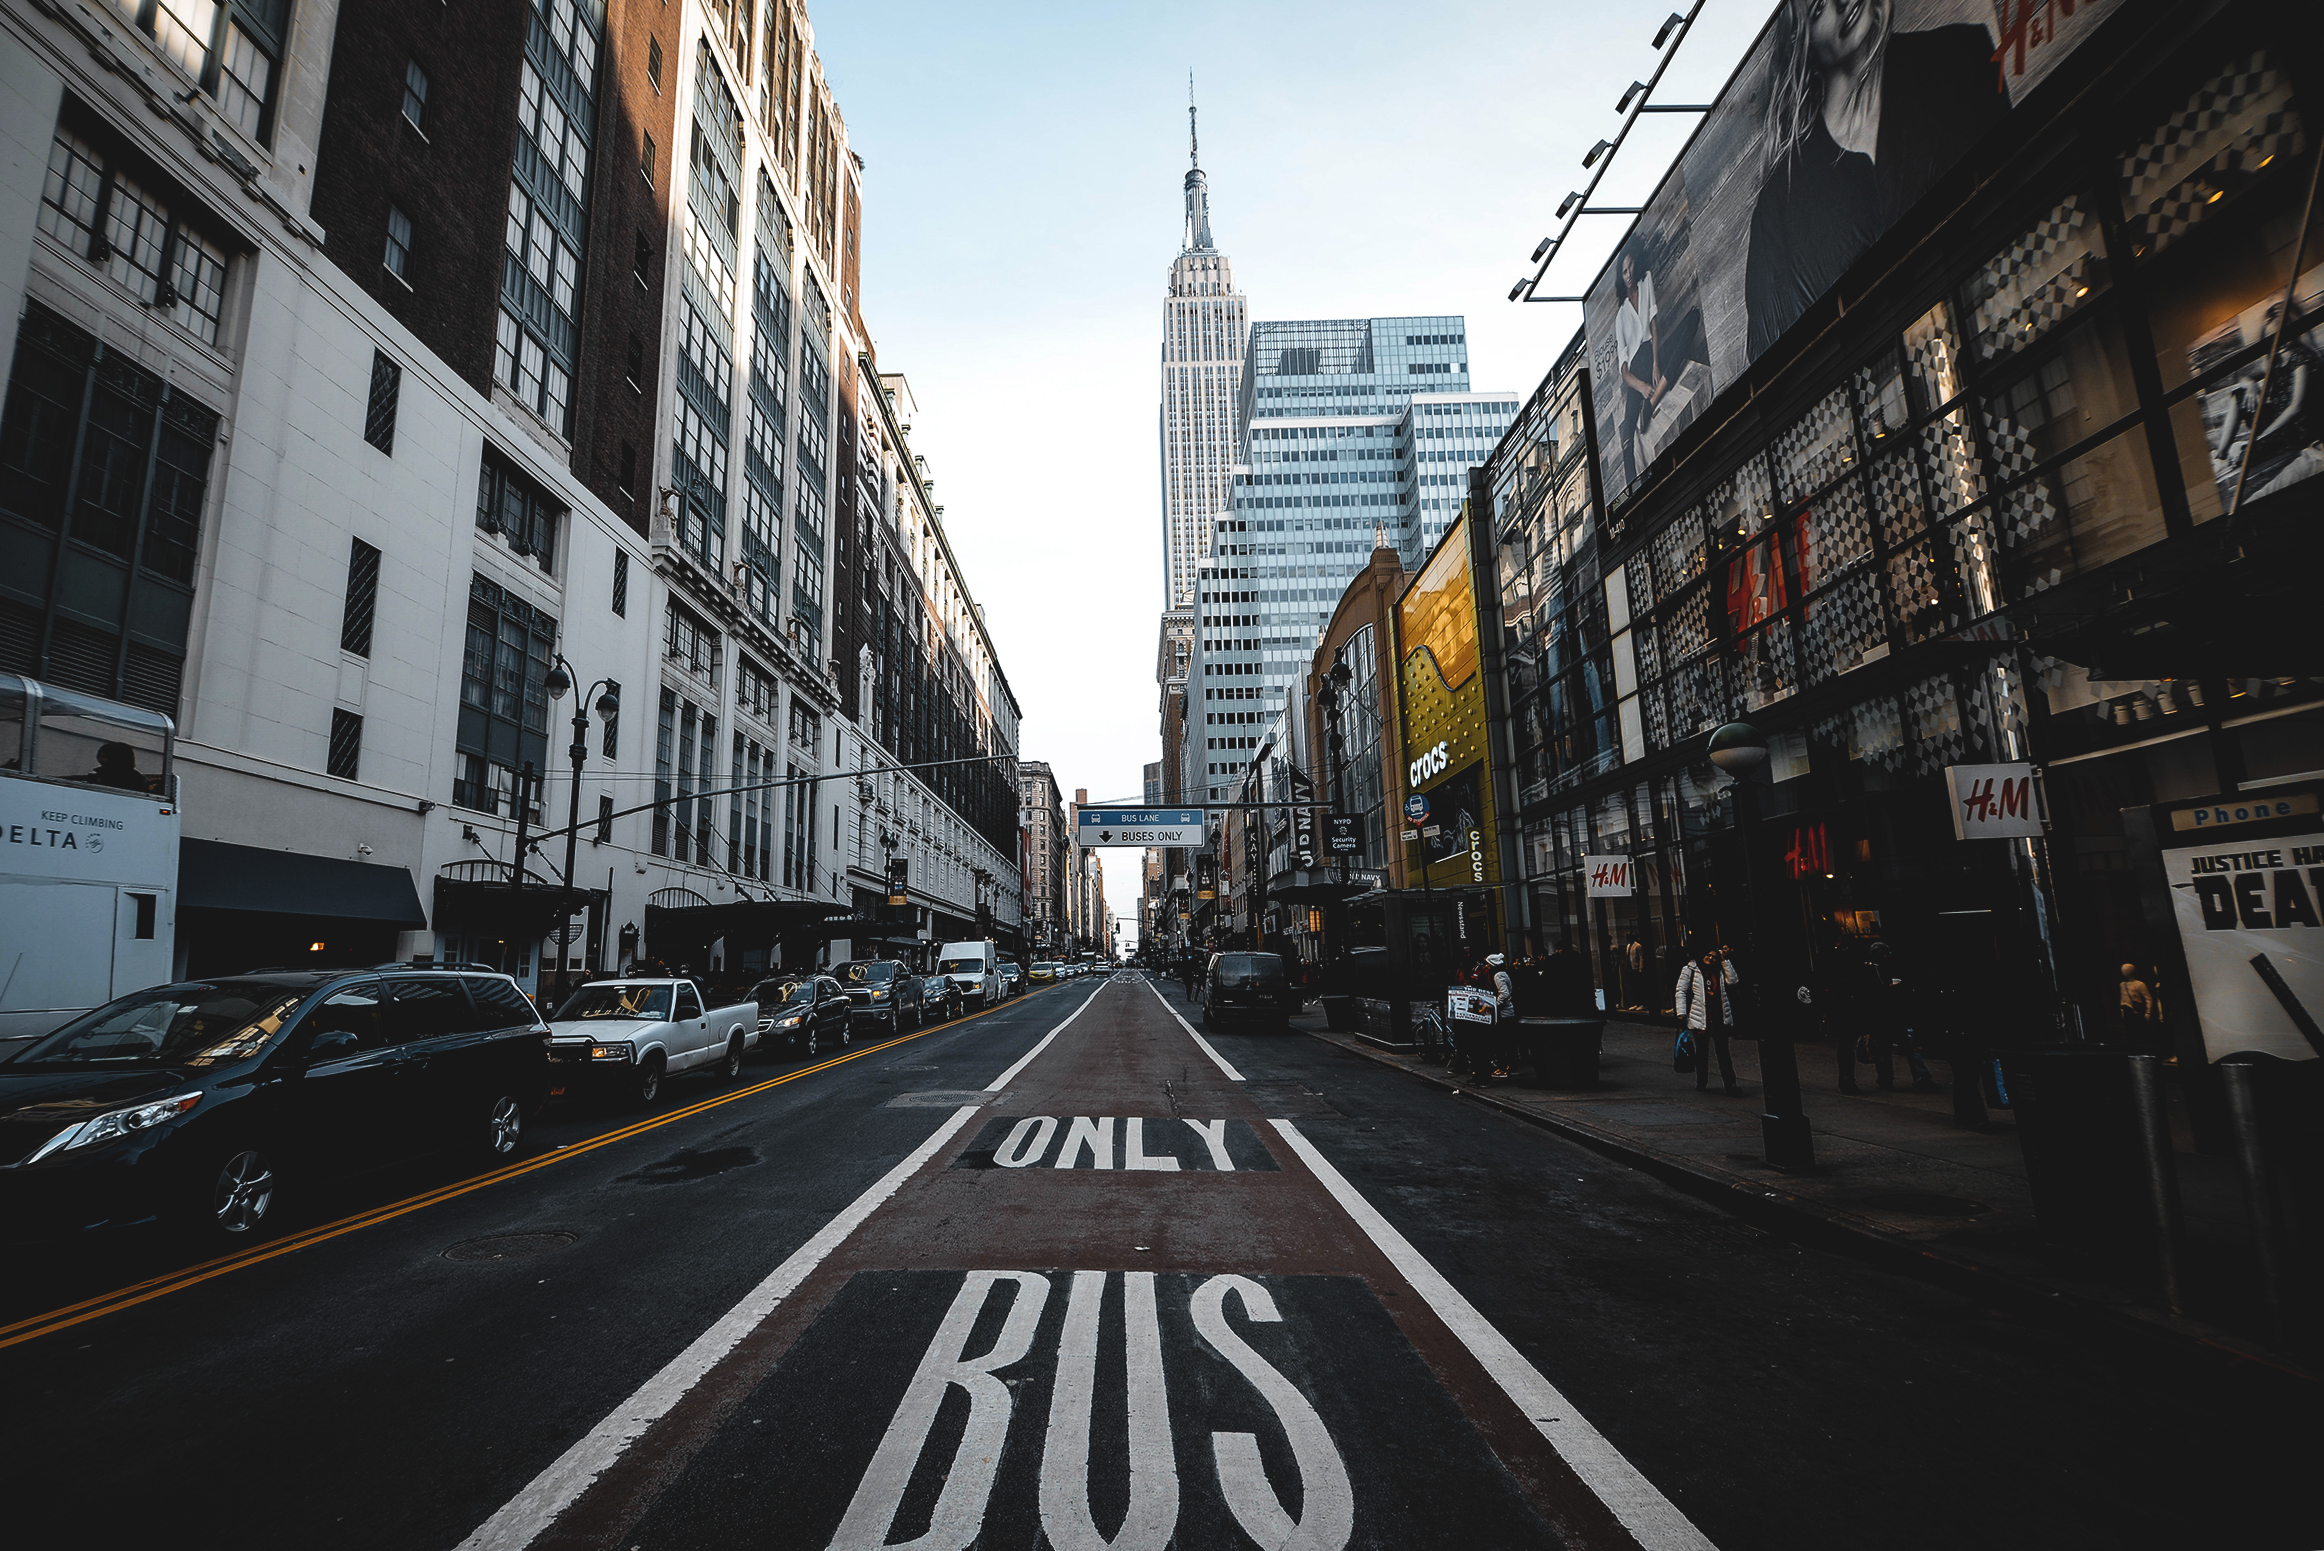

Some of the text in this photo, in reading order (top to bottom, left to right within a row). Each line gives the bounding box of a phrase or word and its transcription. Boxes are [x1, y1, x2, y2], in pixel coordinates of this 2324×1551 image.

[1410, 740, 1448, 788] crocs
[1294, 782, 1311, 830] NAVY
[1963, 776, 2029, 822] H&M
[2194, 801, 2291, 826] Phone
[41, 810, 124, 830] KEEP CLIMBING
[1121, 814, 1159, 823] BUS LANE
[0, 825, 77, 849] ELTA
[1121, 831, 1183, 842] BUSES ONLY
[1250, 832, 1258, 862] KAY
[1783, 821, 1828, 880] H&M
[1469, 830, 1483, 882] crocs
[2191, 849, 2284, 874] JUSTICE
[1360, 873, 1381, 881] NAVY
[1591, 863, 1627, 888] H&M
[1457, 901, 1467, 939] Newsstand
[993, 1115, 1236, 1172] ONLY
[825, 1270, 1354, 1551] BUS
